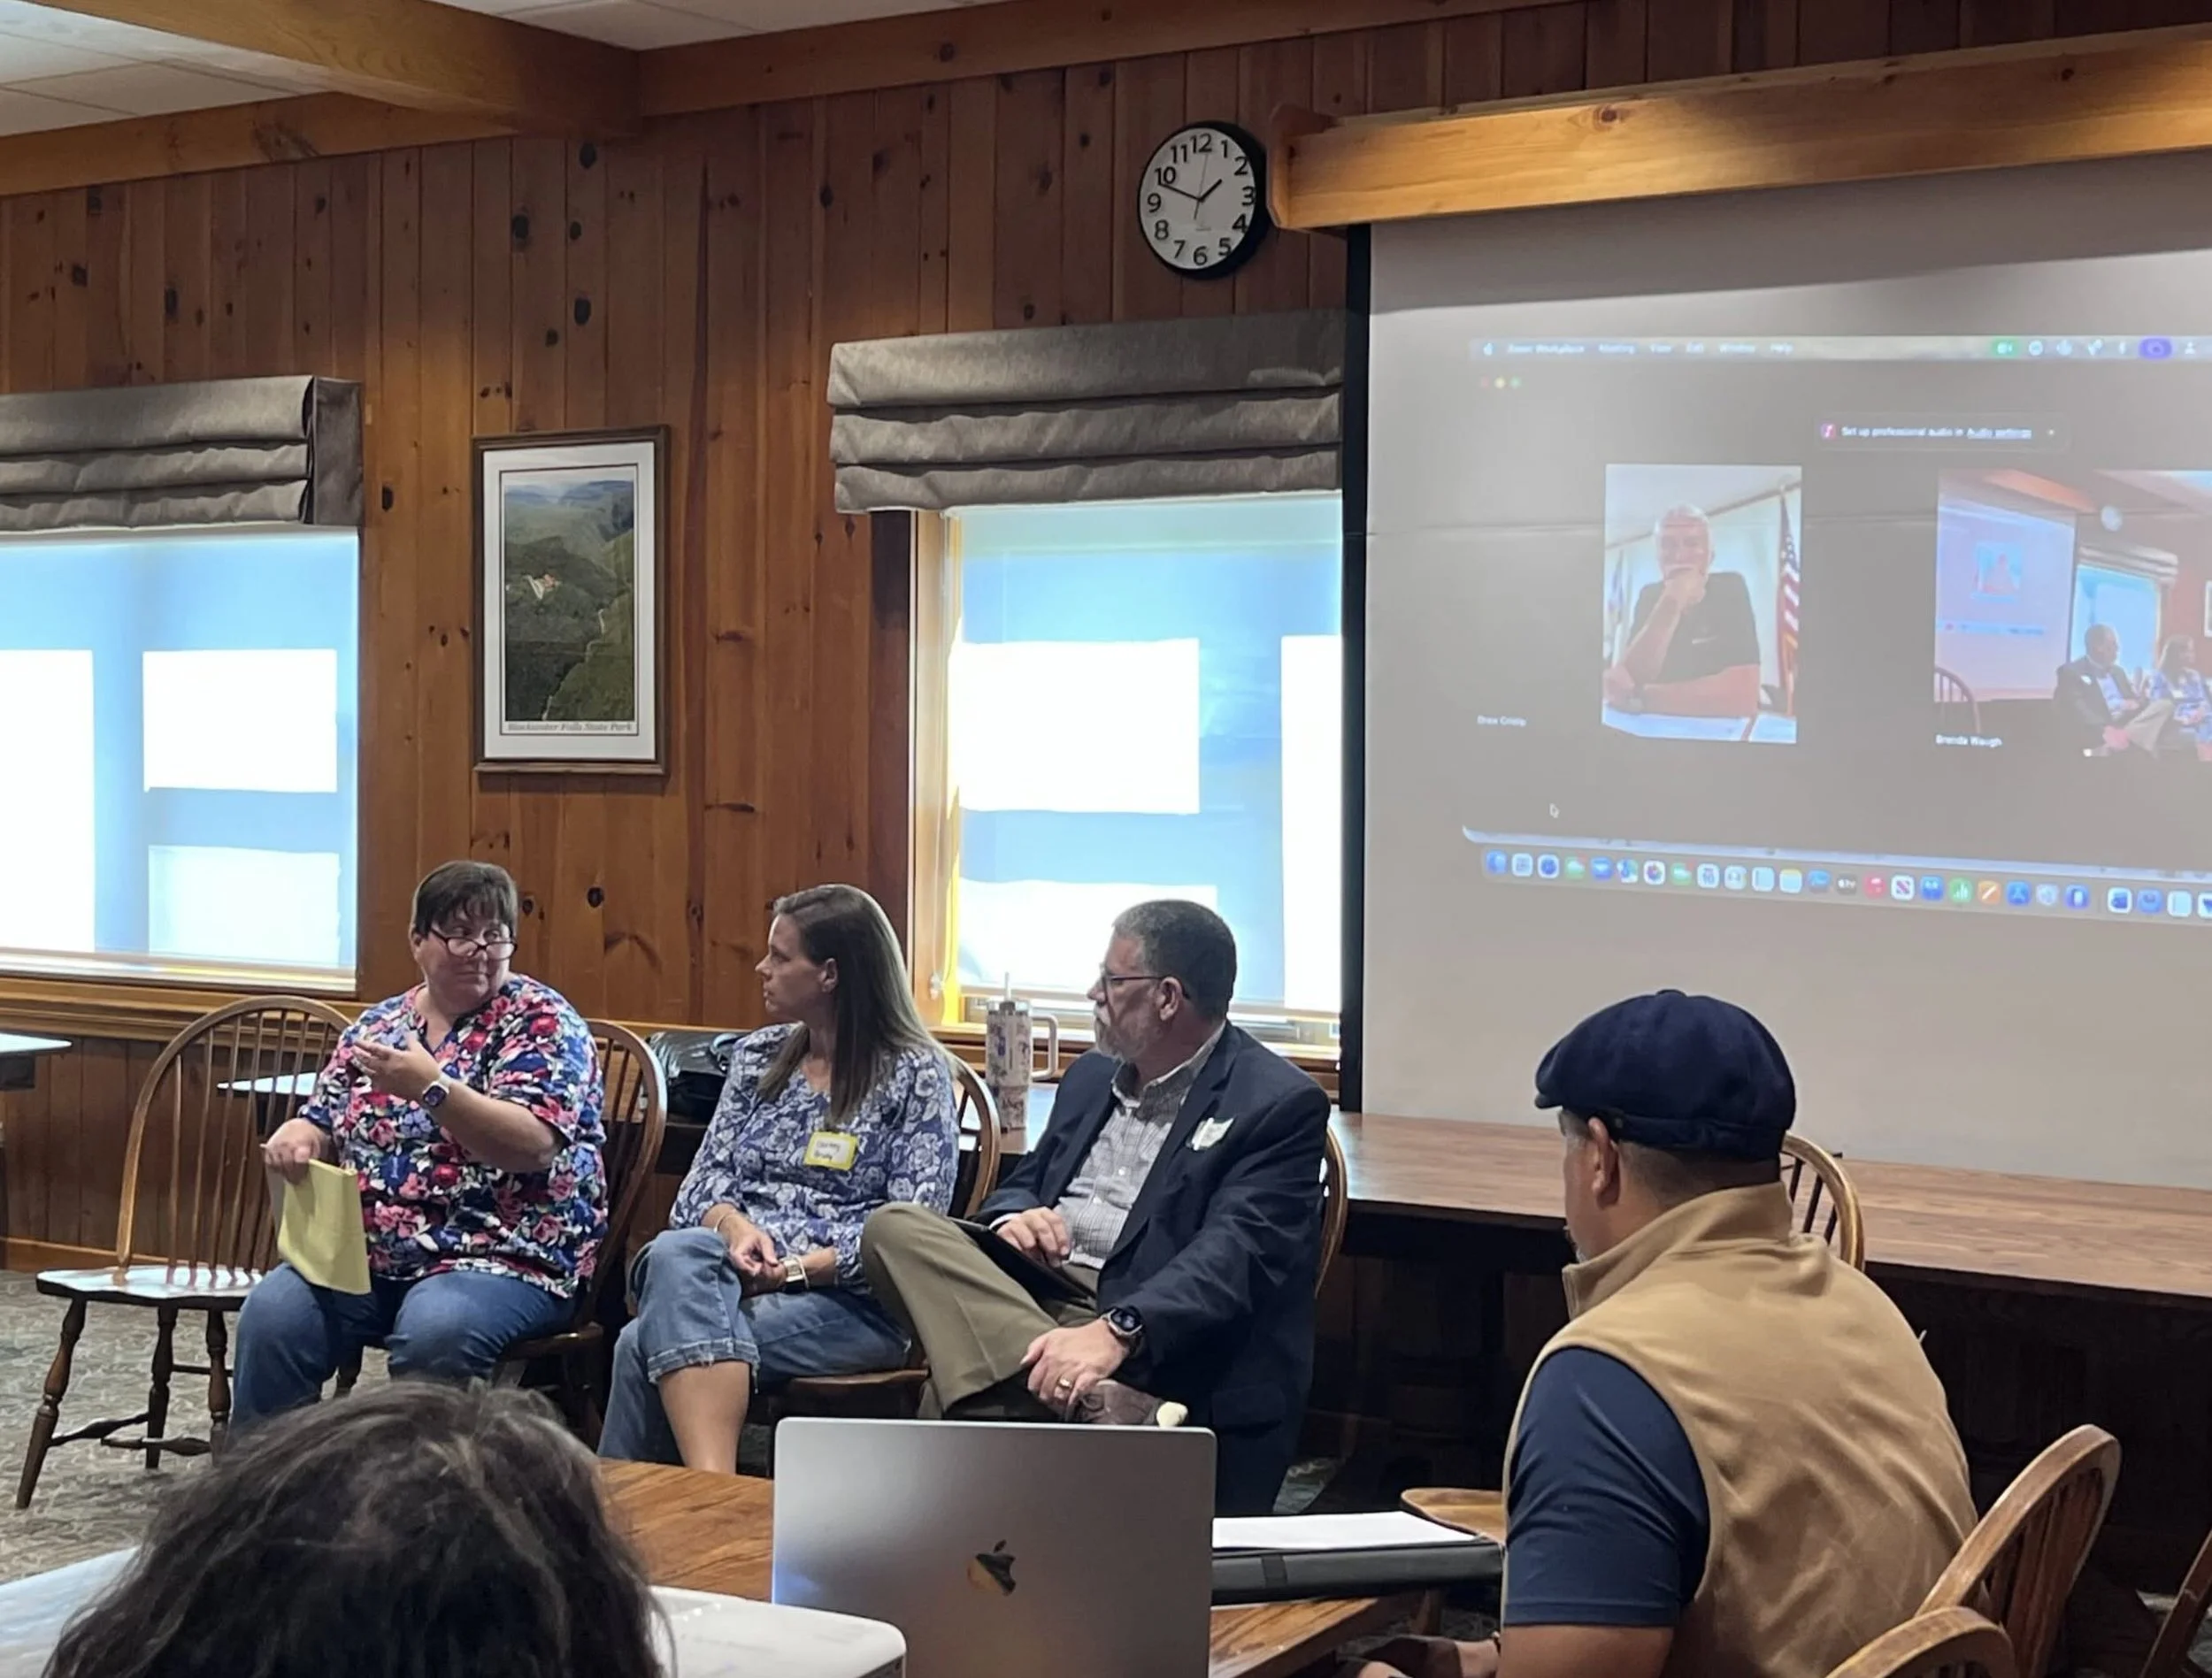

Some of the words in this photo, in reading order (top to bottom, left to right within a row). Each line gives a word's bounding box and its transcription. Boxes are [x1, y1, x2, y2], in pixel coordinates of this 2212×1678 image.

[1190, 134, 1212, 154] 12
[1221, 140, 1228, 158] 1
[1171, 145, 1187, 164] 11
[1154, 166, 1176, 186] 10
[1233, 156, 1248, 176] 2
[1147, 193, 1162, 213] 9
[1241, 186, 1256, 206] 3
[1154, 219, 1169, 241] 8
[1232, 214, 1248, 234] 4
[1174, 240, 1186, 258] 7
[1194, 246, 1208, 265] 6
[1218, 237, 1232, 257] 5
